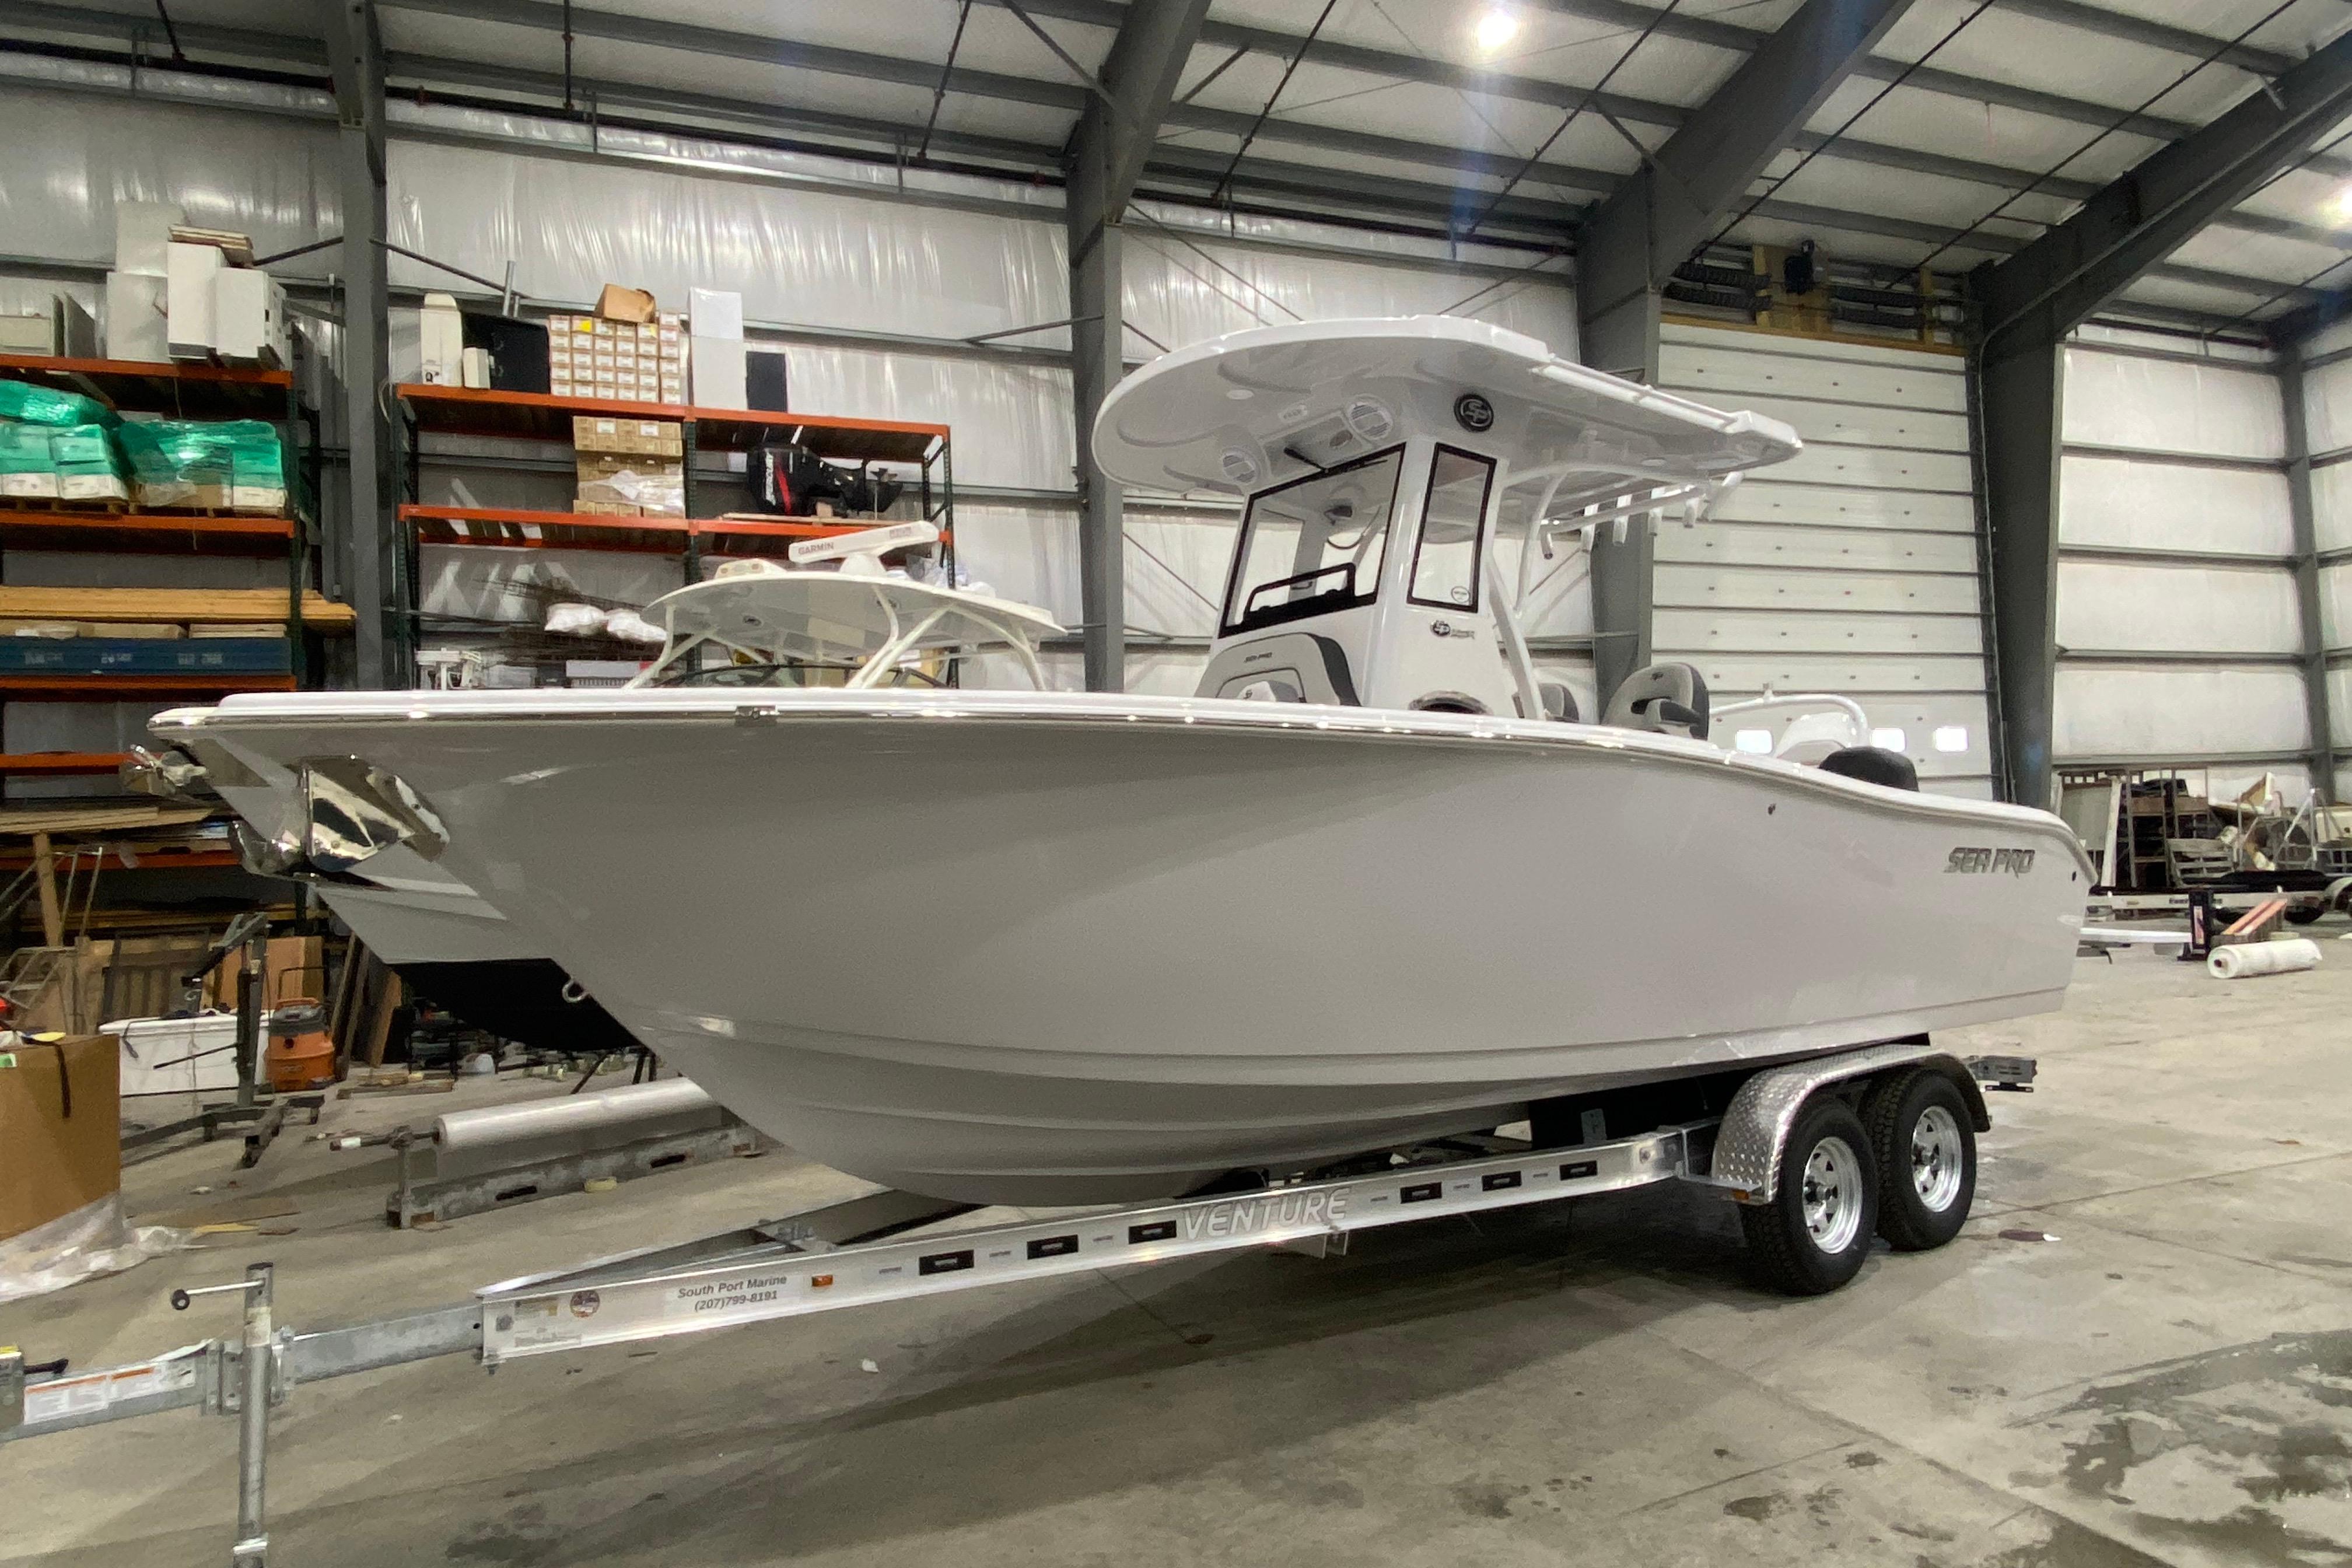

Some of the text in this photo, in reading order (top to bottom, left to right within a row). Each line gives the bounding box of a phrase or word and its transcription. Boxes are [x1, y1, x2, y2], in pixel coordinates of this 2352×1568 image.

[797, 541, 835, 555] GARMIN
[1943, 847, 2036, 878] SEA PRO
[1184, 1186, 1351, 1240] VENTURE
[677, 1275, 788, 1298] South Port Marine
[694, 1290, 778, 1312] (207)799-8191
